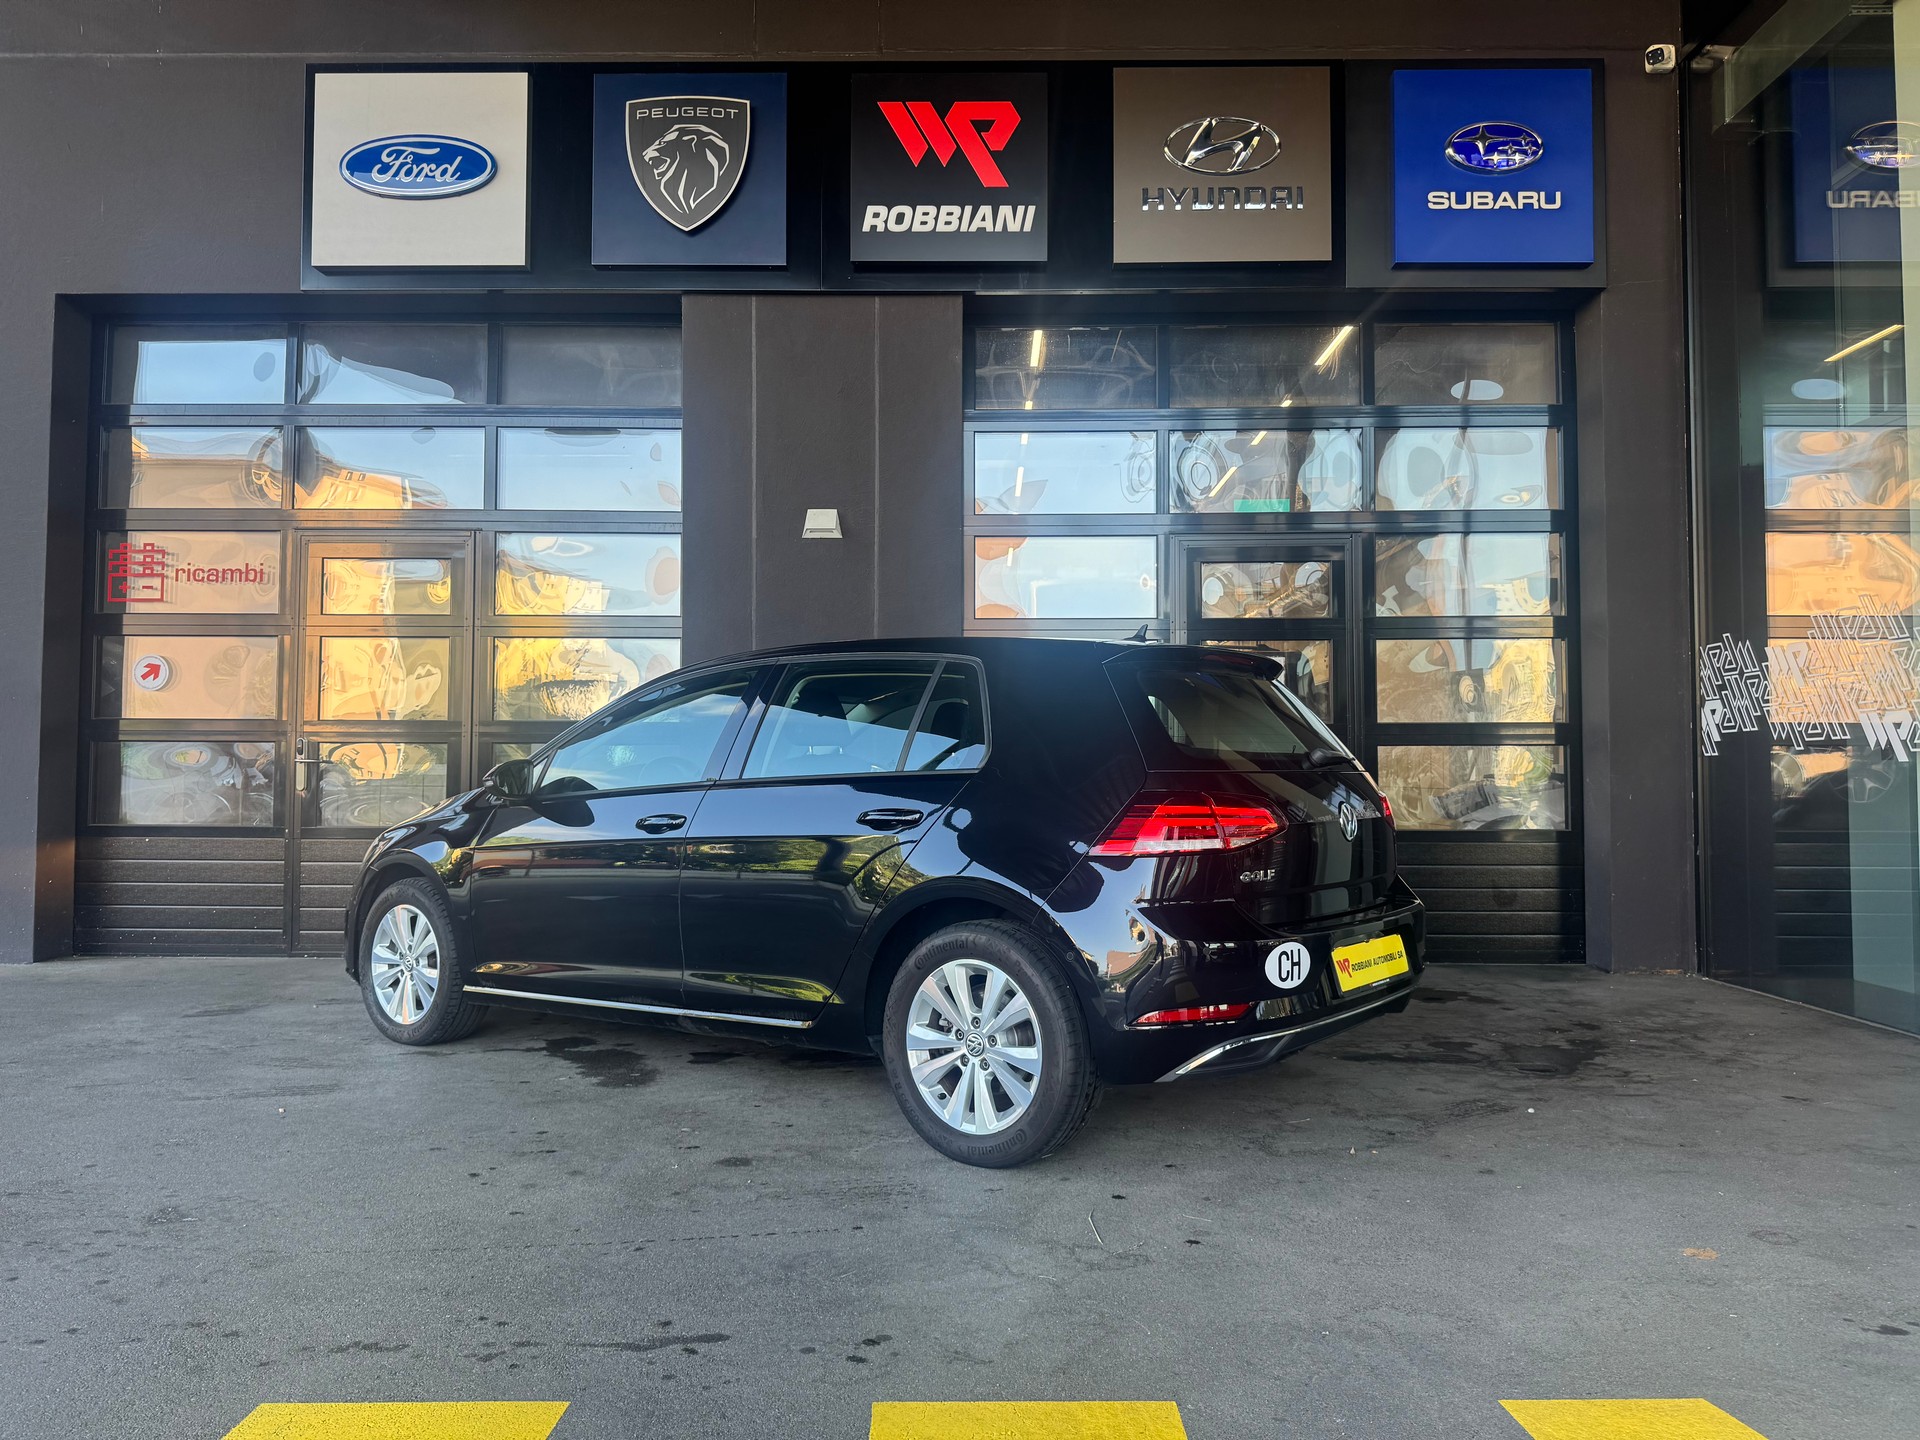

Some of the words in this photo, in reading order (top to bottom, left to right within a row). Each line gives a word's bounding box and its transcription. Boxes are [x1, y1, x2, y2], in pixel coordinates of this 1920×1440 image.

[636, 107, 739, 120] PEUGEOT
[371, 146, 461, 183] Ford
[1141, 187, 1304, 211] HYUNDAI
[1427, 191, 1562, 210] SUBARU
[862, 205, 1036, 232] ROBBIANI
[174, 563, 264, 583] ricambi
[1240, 869, 1275, 883] GOLF
[1278, 949, 1301, 982] CH
[1351, 959, 1372, 972] ROBBIANI
[1373, 953, 1397, 966] AUTOMOBILI
